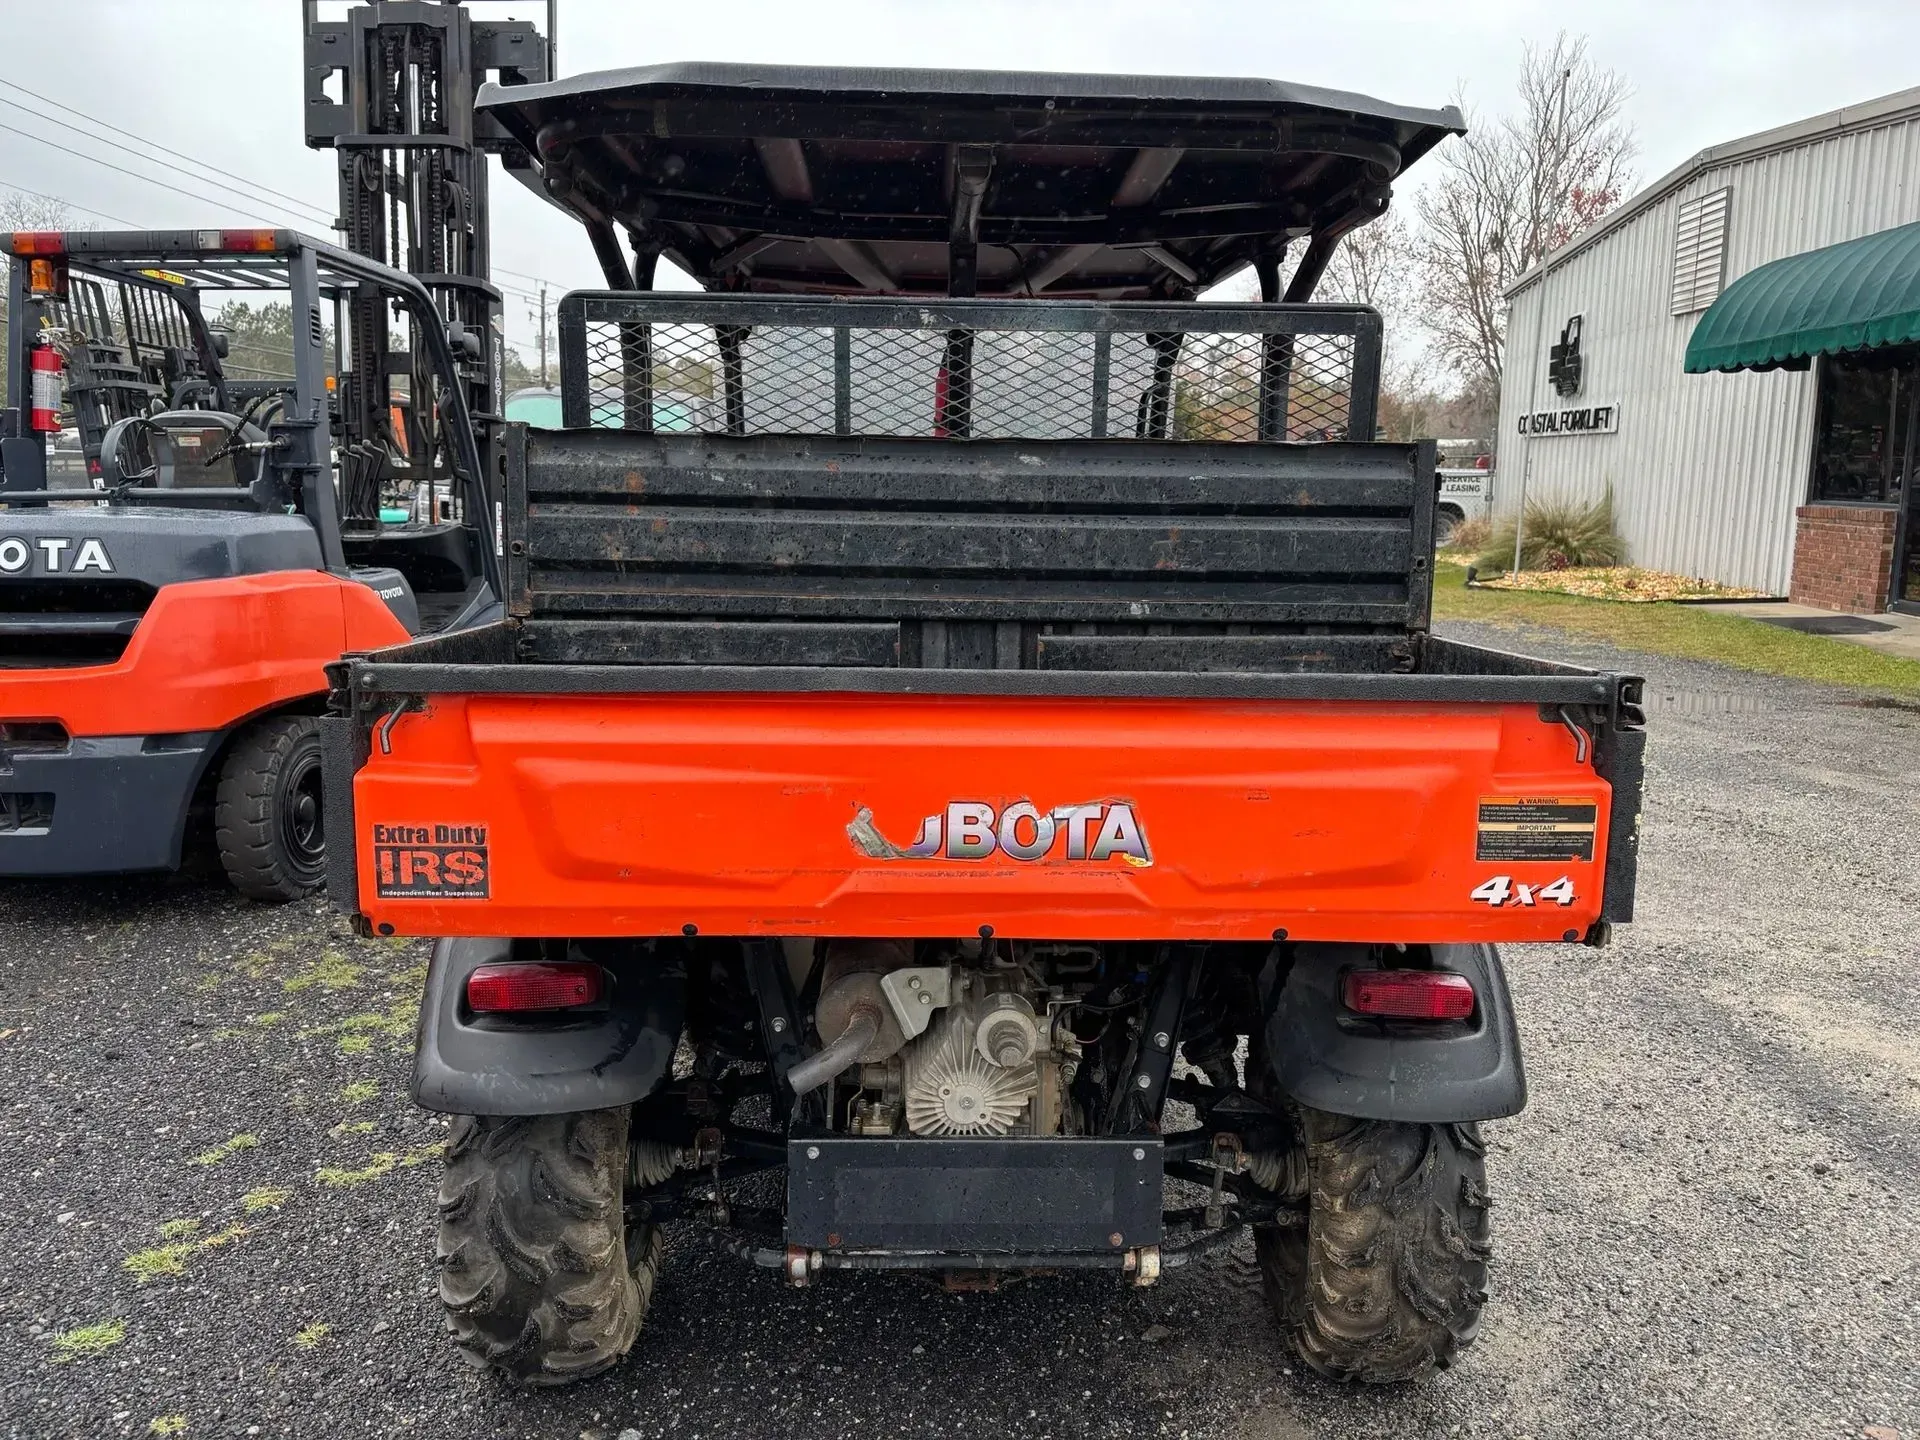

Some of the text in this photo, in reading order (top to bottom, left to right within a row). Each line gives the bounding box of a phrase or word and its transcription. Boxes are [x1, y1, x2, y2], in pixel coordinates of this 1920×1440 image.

[493, 337, 502, 417] TOYOTA
[1560, 406, 1612, 431] FORKLIFT
[1446, 484, 1481, 492] LEASING
[381, 586, 405, 600] TOYOTA
[374, 824, 486, 845] Extra Duty
[910, 800, 1150, 861] UBOTA
[380, 850, 485, 885] IRS
[1470, 875, 1576, 907] 4x4
